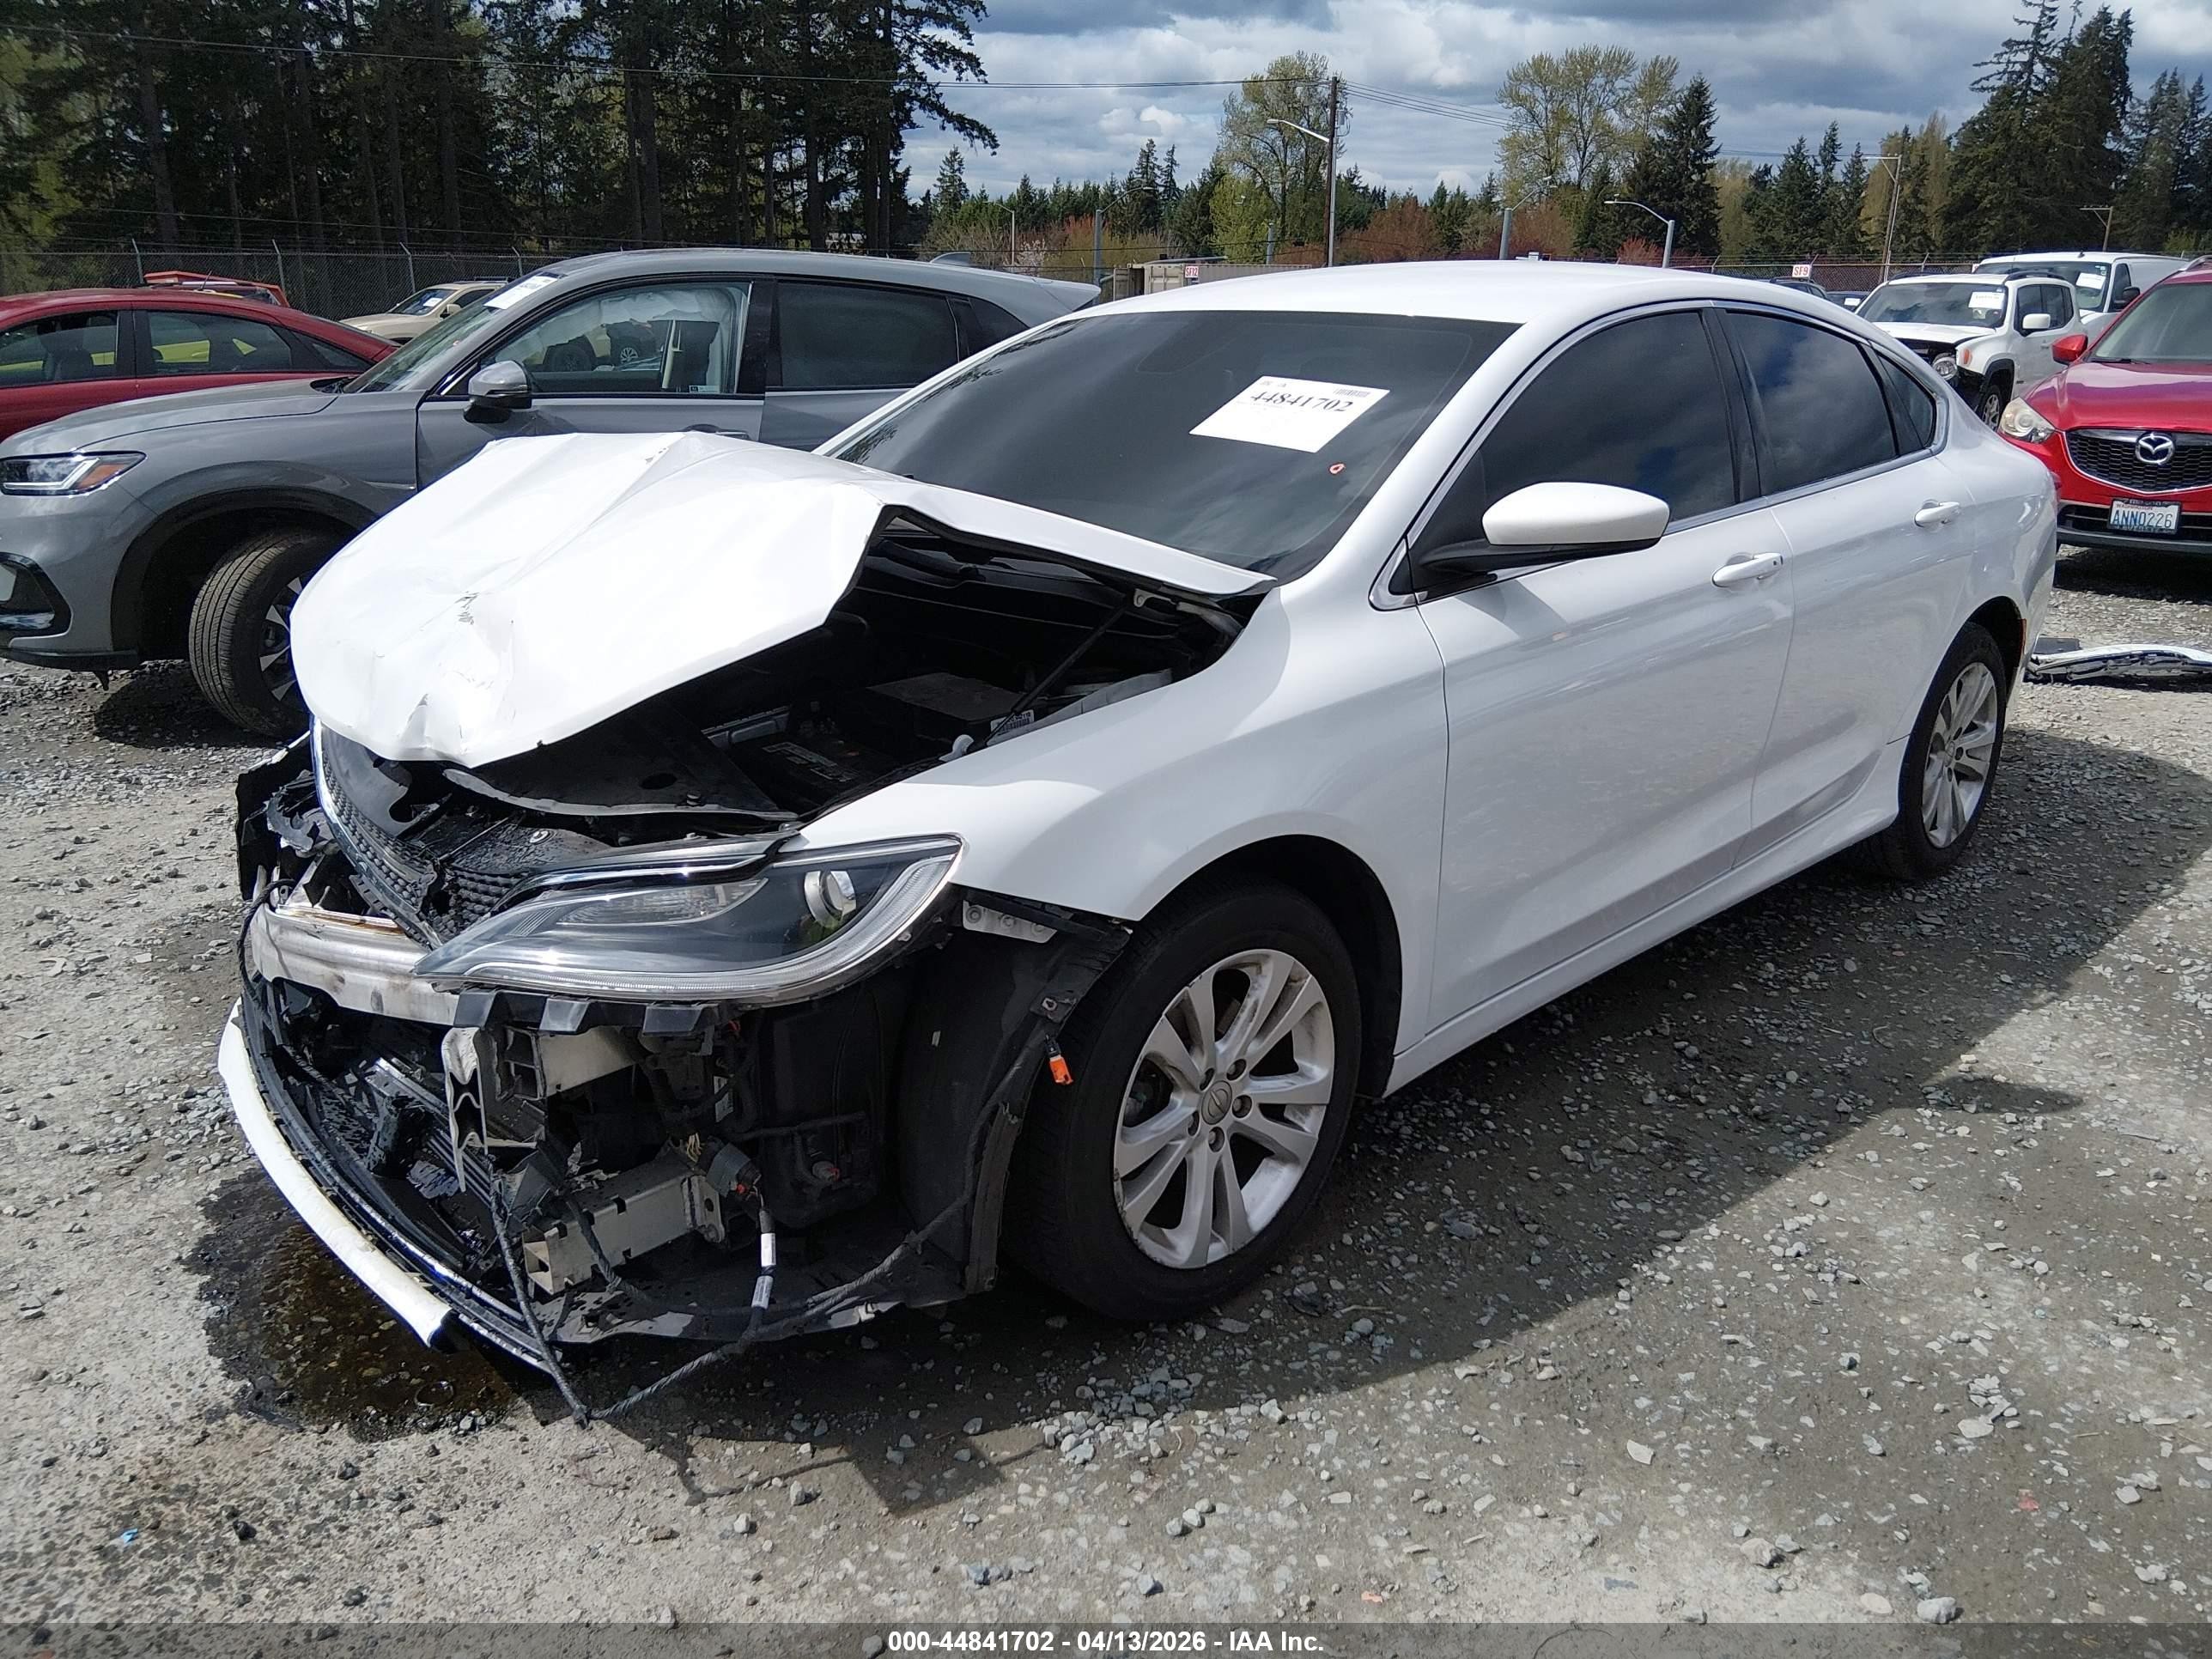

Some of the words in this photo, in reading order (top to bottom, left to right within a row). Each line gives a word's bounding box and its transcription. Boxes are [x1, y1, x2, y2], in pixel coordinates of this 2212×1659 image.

[1185, 267, 1198, 276] SF12
[1794, 266, 1808, 276] SF9
[1250, 391, 1353, 412] 44841702
[2112, 509, 2173, 528] ANN0226
